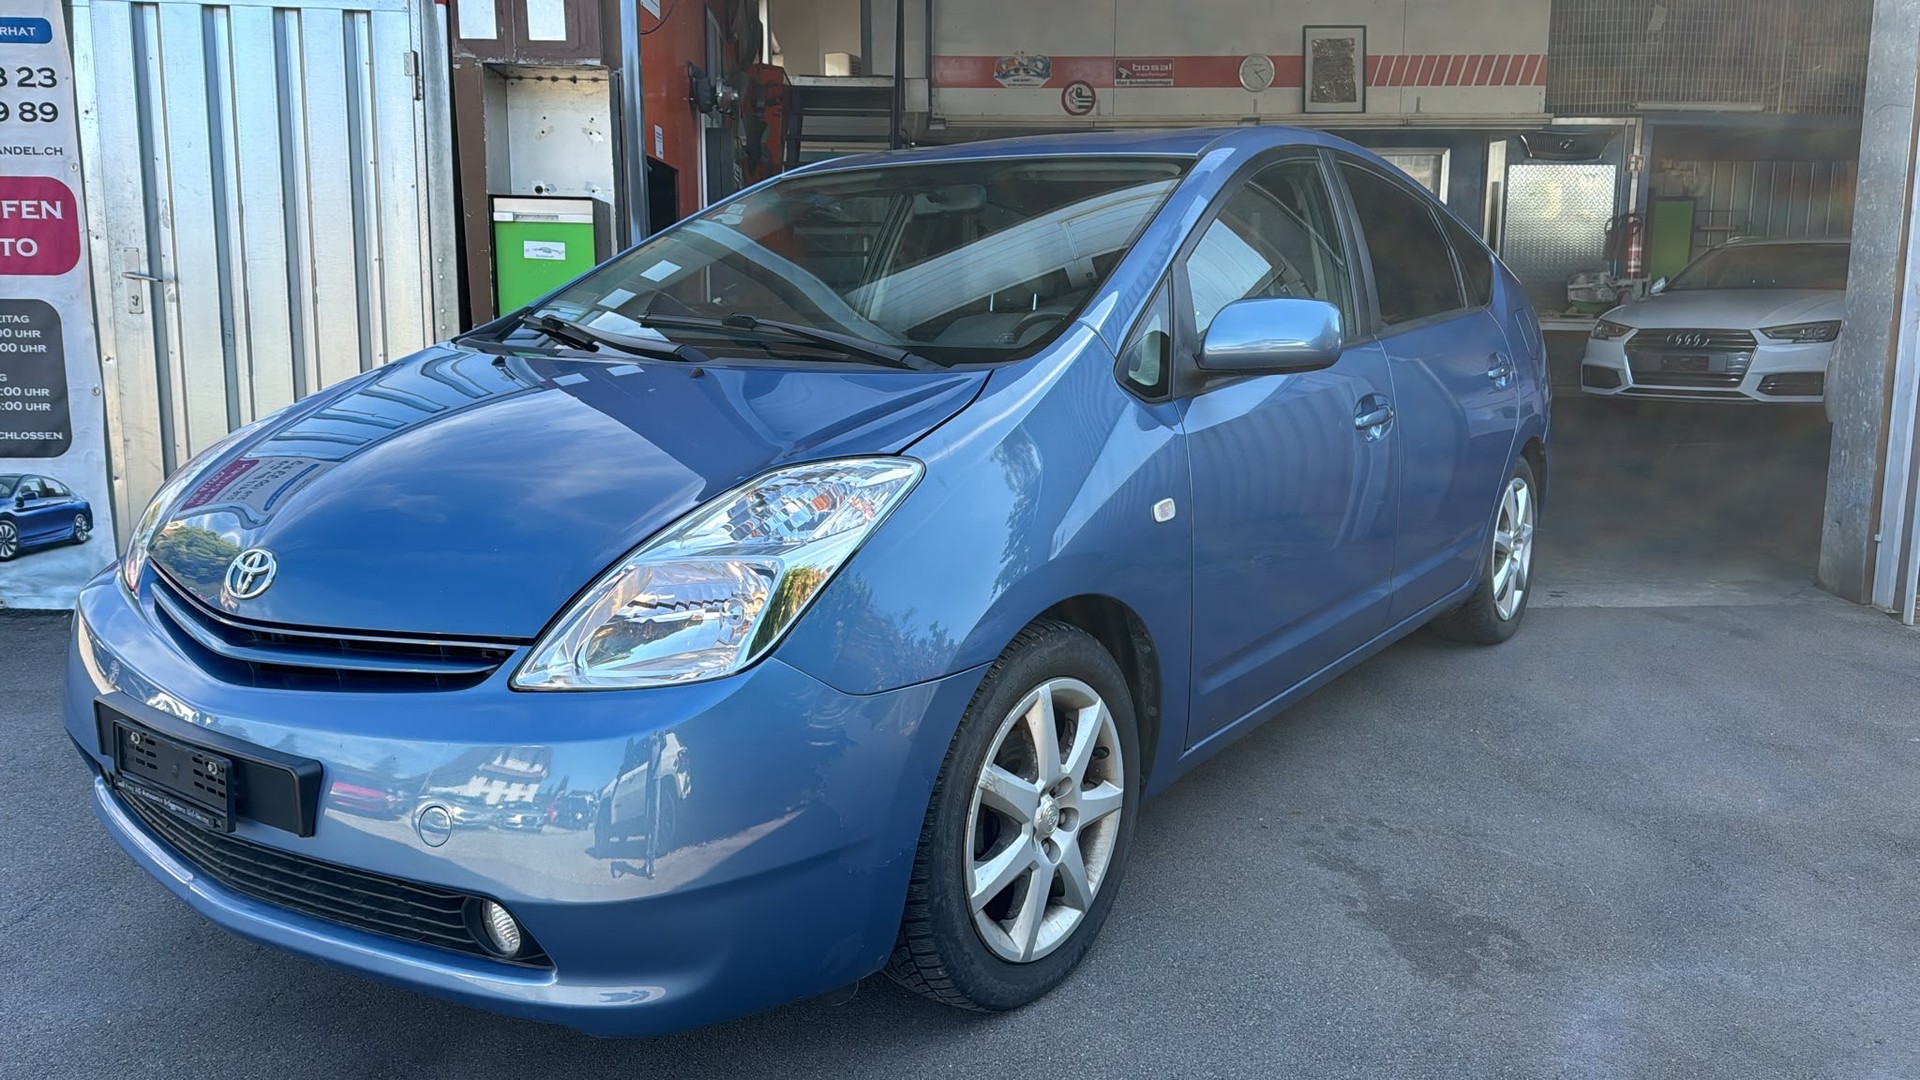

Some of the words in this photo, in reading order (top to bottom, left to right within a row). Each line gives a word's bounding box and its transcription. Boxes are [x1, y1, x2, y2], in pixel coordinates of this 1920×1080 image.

[0, 26, 36, 36] RHAT
[1132, 63, 1172, 71] bosal
[16, 66, 57, 88] 23
[18, 101, 59, 122] 89
[0, 146, 64, 156] NDEL.CH
[1, 200, 63, 219] FEN
[0, 237, 38, 257] TO
[0, 314, 30, 324] ITAG
[15, 329, 41, 338] UHR
[20, 344, 47, 353] UHR
[24, 387, 50, 397] UHR
[25, 402, 52, 411] UHR
